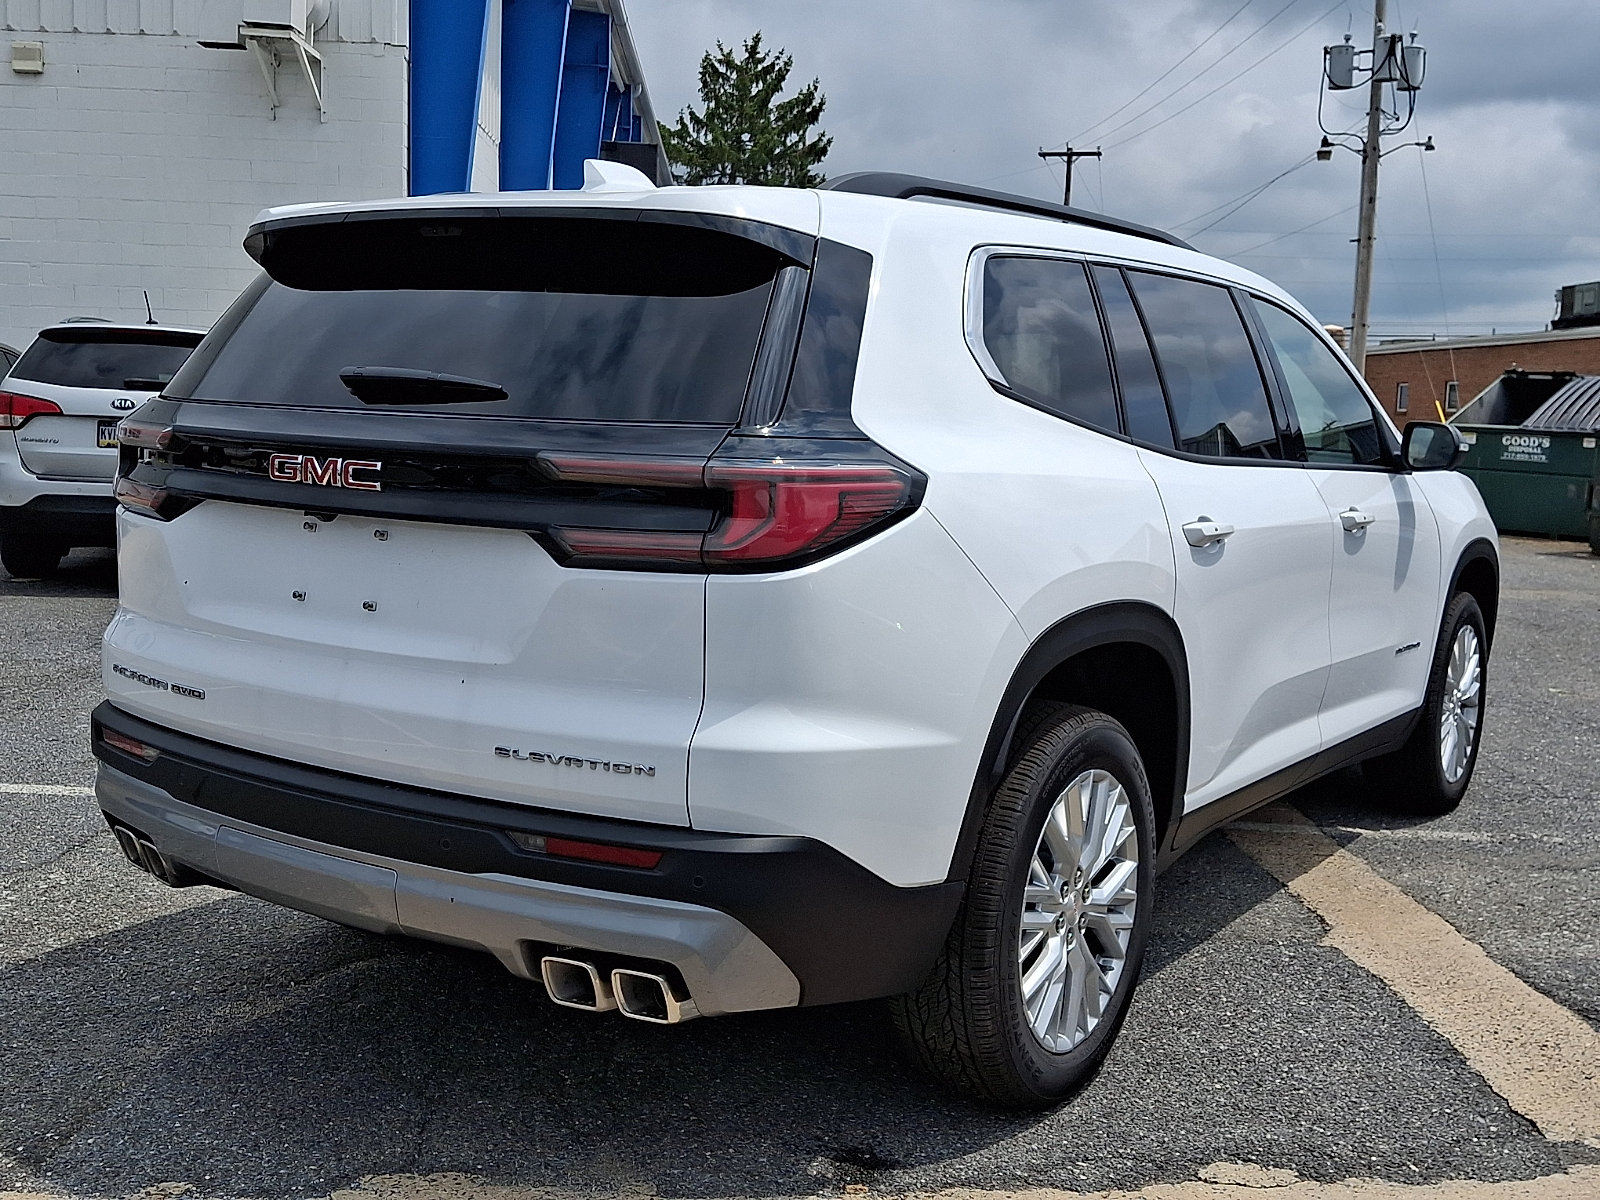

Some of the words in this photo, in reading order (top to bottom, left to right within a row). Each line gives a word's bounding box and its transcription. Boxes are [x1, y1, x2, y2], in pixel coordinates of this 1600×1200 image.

[114, 400, 133, 408] KIA
[1502, 435, 1550, 448] GOOD'S
[269, 453, 382, 491] GMC
[494, 745, 656, 777] ELEVATION
